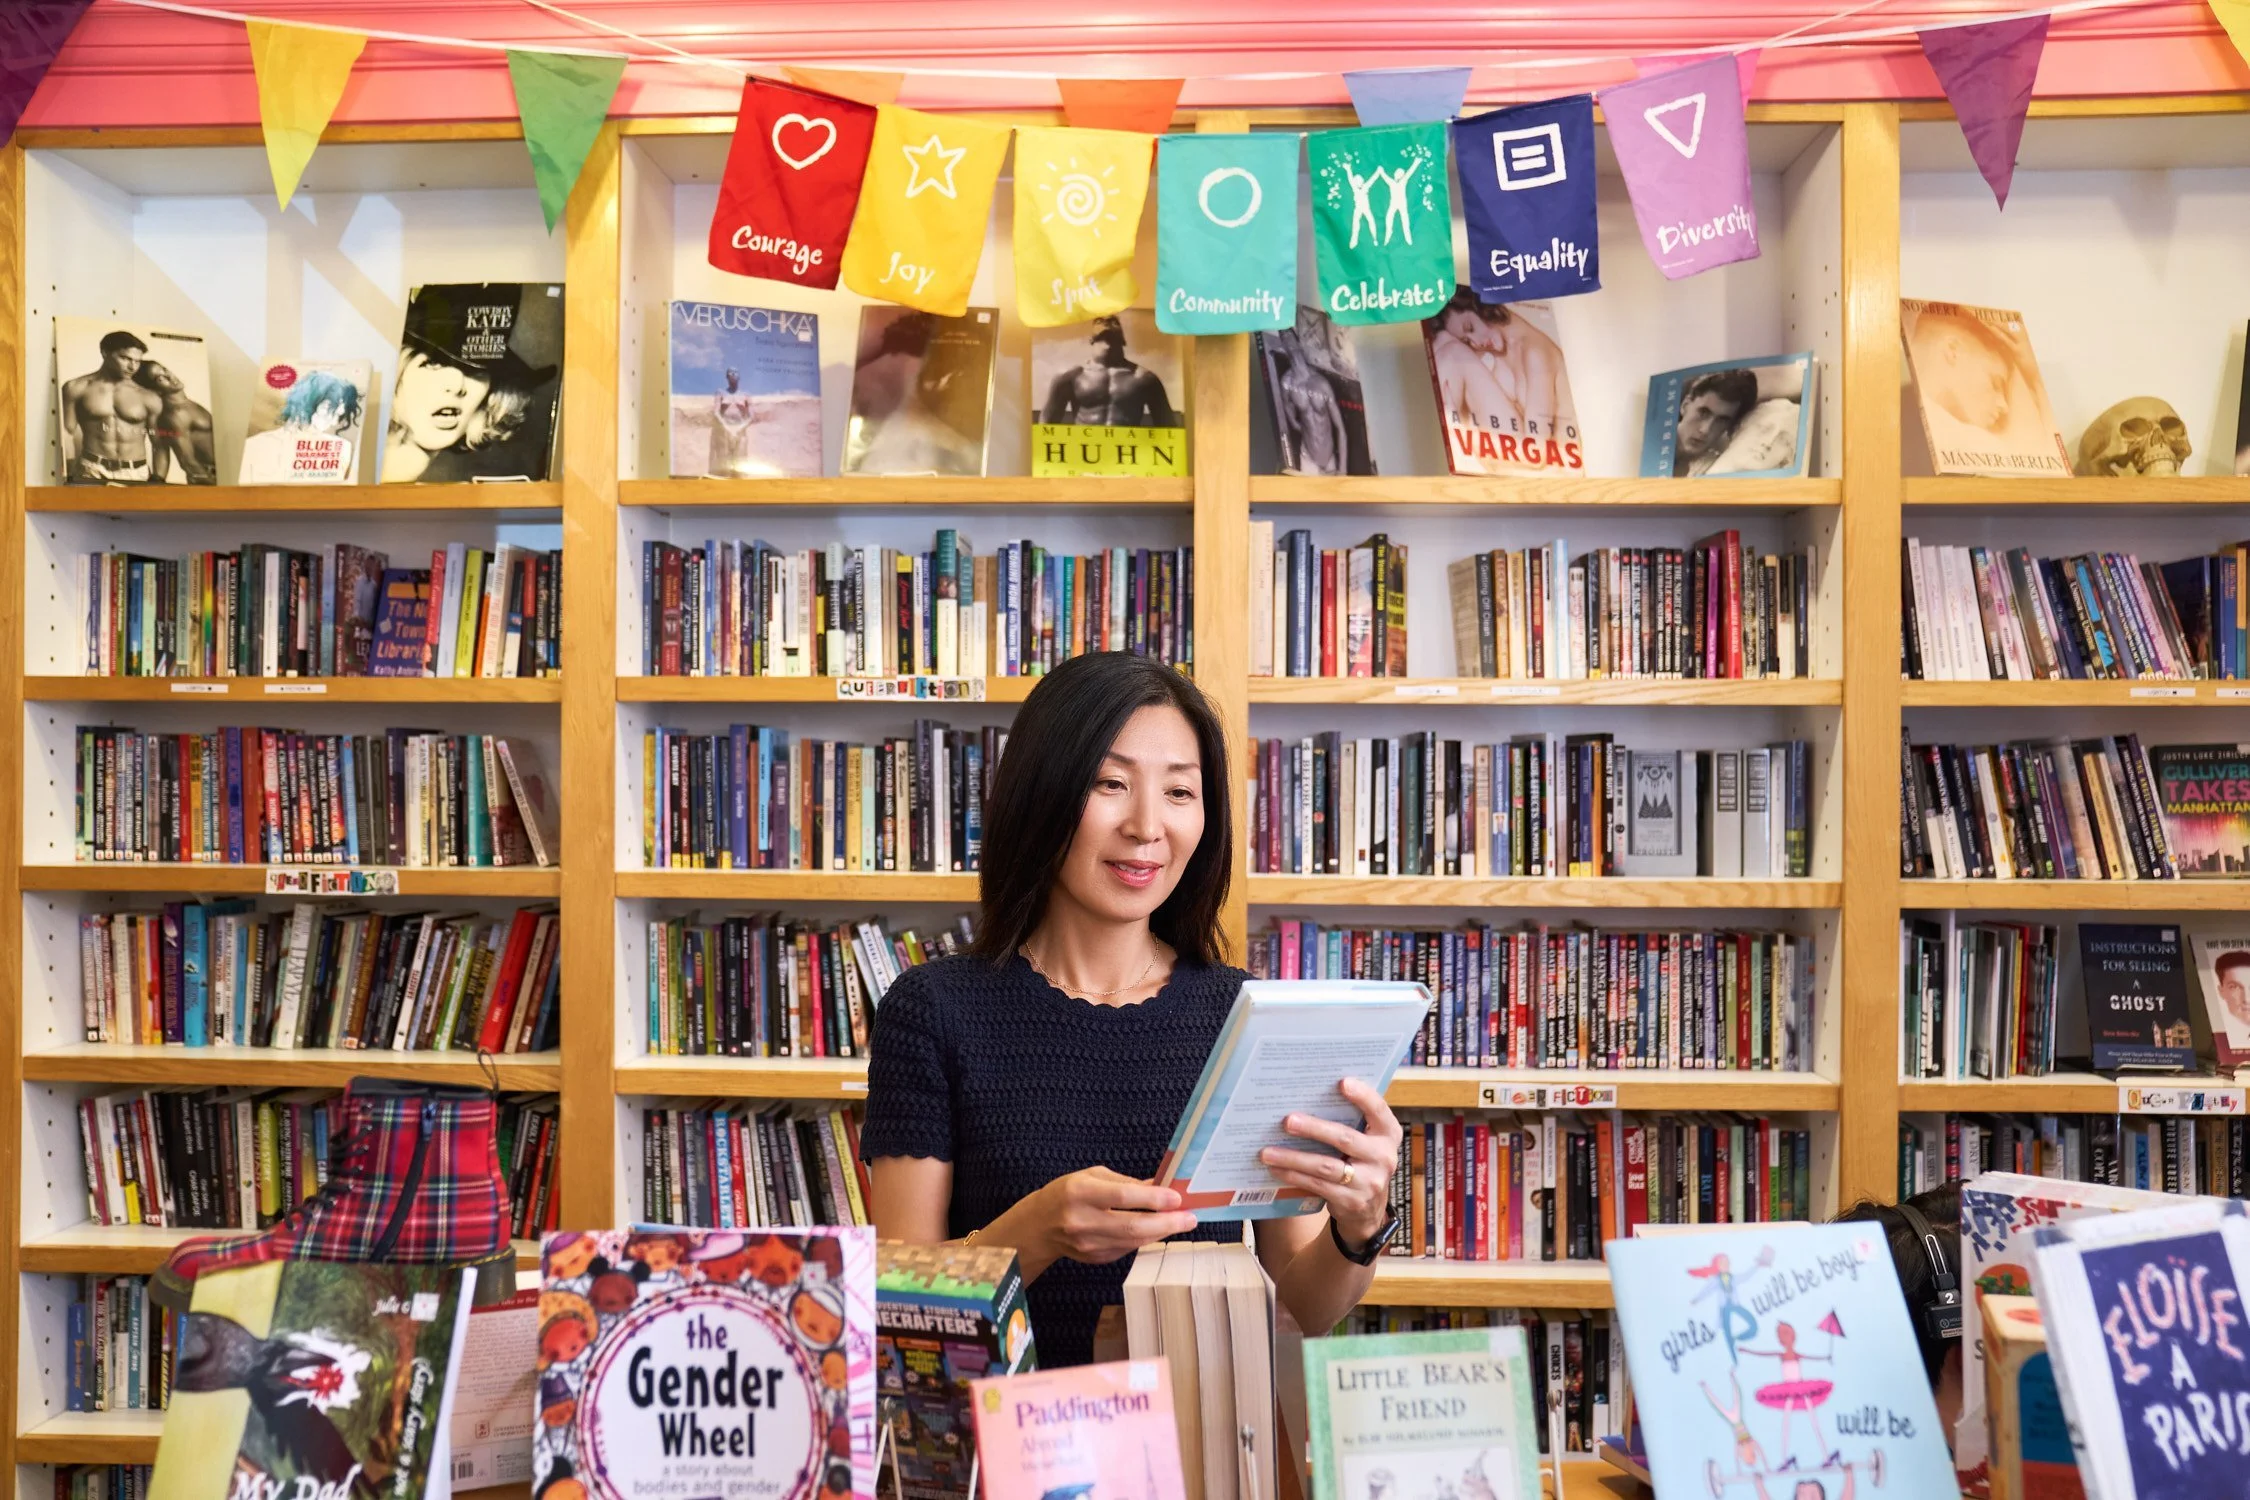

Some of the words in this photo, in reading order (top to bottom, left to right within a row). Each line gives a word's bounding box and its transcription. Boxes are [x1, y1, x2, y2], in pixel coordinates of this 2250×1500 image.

[1656, 204, 1756, 254] Diversity
[731, 225, 823, 275] Courage
[1490, 238, 1590, 283] Equality
[880, 251, 937, 295] Joy
[1169, 287, 1285, 321] Community
[1330, 277, 1446, 313] Celebrate!
[1901, 300, 1959, 317] NORBERT
[466, 316, 511, 328] KATE
[460, 344, 507, 353] STORIES
[466, 334, 505, 344] OTHER
[1042, 427, 1177, 440] MICHAEL
[1452, 410, 1577, 438] ALBERTO
[1658, 377, 1677, 477] UNBEAMS
[296, 440, 333, 451] BLUE
[1042, 443, 1177, 466] HUHN
[1453, 428, 1582, 469] VARGAS
[292, 459, 340, 470] COLOR
[2010, 454, 2064, 471] BERLIN
[1377, 545, 1385, 557] The
[1008, 549, 1018, 583] COMING
[1377, 559, 1385, 582] Venice
[1480, 564, 1489, 595] Getting
[1674, 565, 1682, 581] THE
[1674, 582, 1682, 609] NIGHT
[2023, 565, 2037, 601] ROMANCE
[229, 592, 237, 616] LUCKY
[387, 600, 411, 618] The
[1008, 584, 1018, 610] HOME
[1377, 583, 1385, 611] Adriana
[1483, 612, 1491, 637] Clean
[326, 736, 335, 758] WILD
[671, 745, 679, 770] COYOTE
[886, 753, 892, 764] NO
[2162, 751, 2195, 761] JUSTIN
[2193, 752, 2219, 760] LUKE
[96, 764, 104, 785] LAST
[279, 750, 287, 784] CHASING
[327, 760, 337, 796] ABANDON
[671, 772, 679, 786] SKY
[908, 755, 916, 783] FINAL
[969, 757, 980, 791] CONFLICT
[1530, 757, 1539, 778] SIDE
[172, 780, 179, 794] WE
[280, 785, 288, 809] LOVE
[1302, 759, 1310, 810] BEFORE
[2165, 780, 2250, 802] TAKES
[96, 786, 104, 811] THING
[969, 794, 981, 828] INTEREST
[1530, 779, 1539, 819] EFFECTS
[2135, 759, 2144, 774] THE
[2140, 778, 2153, 811] ANGELIC
[2149, 813, 2165, 855] DARKNESS
[2167, 801, 2250, 815] MANHATTAN
[967, 839, 980, 856] JAE
[1444, 933, 1453, 965] HONOR
[2090, 941, 2177, 955] INSTRUCTIONS
[2220, 940, 2231, 949] YOU
[1547, 950, 1556, 976] OATH
[1597, 948, 1607, 989] TAKING
[1627, 949, 1636, 988] TRAUMA
[2103, 960, 2127, 972] FOR
[2129, 960, 2171, 973] SEEING
[2132, 979, 2141, 990] A
[1547, 985, 1556, 1019] HONOR
[1597, 990, 1607, 1015] FIRE
[2109, 994, 2166, 1012] GHOST
[527, 1114, 540, 1145] DEADLY
[2166, 1119, 2177, 1160] MIDLIFE
[2182, 1127, 2190, 1152] ELVIS
[1968, 1138, 1979, 1165] DRY
[262, 1151, 271, 1182] STORY
[1476, 1162, 1486, 1198] Without
[2182, 1156, 2190, 1190] DURAN
[1700, 1173, 1713, 1205] BAIT
[1476, 1201, 1487, 1240] Sanction
[1944, 1292, 1955, 1304] 2
[923, 1304, 960, 1318] STORIES
[963, 1309, 982, 1321] FOR
[1660, 1319, 1716, 1375] girls
[1751, 1270, 1795, 1317] will
[1795, 1265, 1823, 1295] be
[687, 1313, 727, 1350] the
[1336, 1367, 1409, 1391] LITTLE
[1422, 1359, 1506, 1387] BEAR'S
[1550, 1344, 1561, 1381] CHOICES
[628, 1346, 784, 1409] Gender
[1015, 1391, 1149, 1428] Paddington
[1380, 1396, 1467, 1422] FRIEND
[1836, 1405, 1883, 1437] will
[1887, 1407, 1917, 1439] be
[658, 1411, 755, 1457] Wheel
[2143, 1391, 2250, 1471] PARIS
[231, 1469, 287, 1500] My
[290, 1463, 363, 1500] Dad
[661, 1466, 670, 1476] a
[674, 1464, 709, 1480] story
[713, 1464, 754, 1476] about
[634, 1479, 688, 1493] bodies
[692, 1481, 722, 1493] and
[727, 1480, 781, 1497] gender
